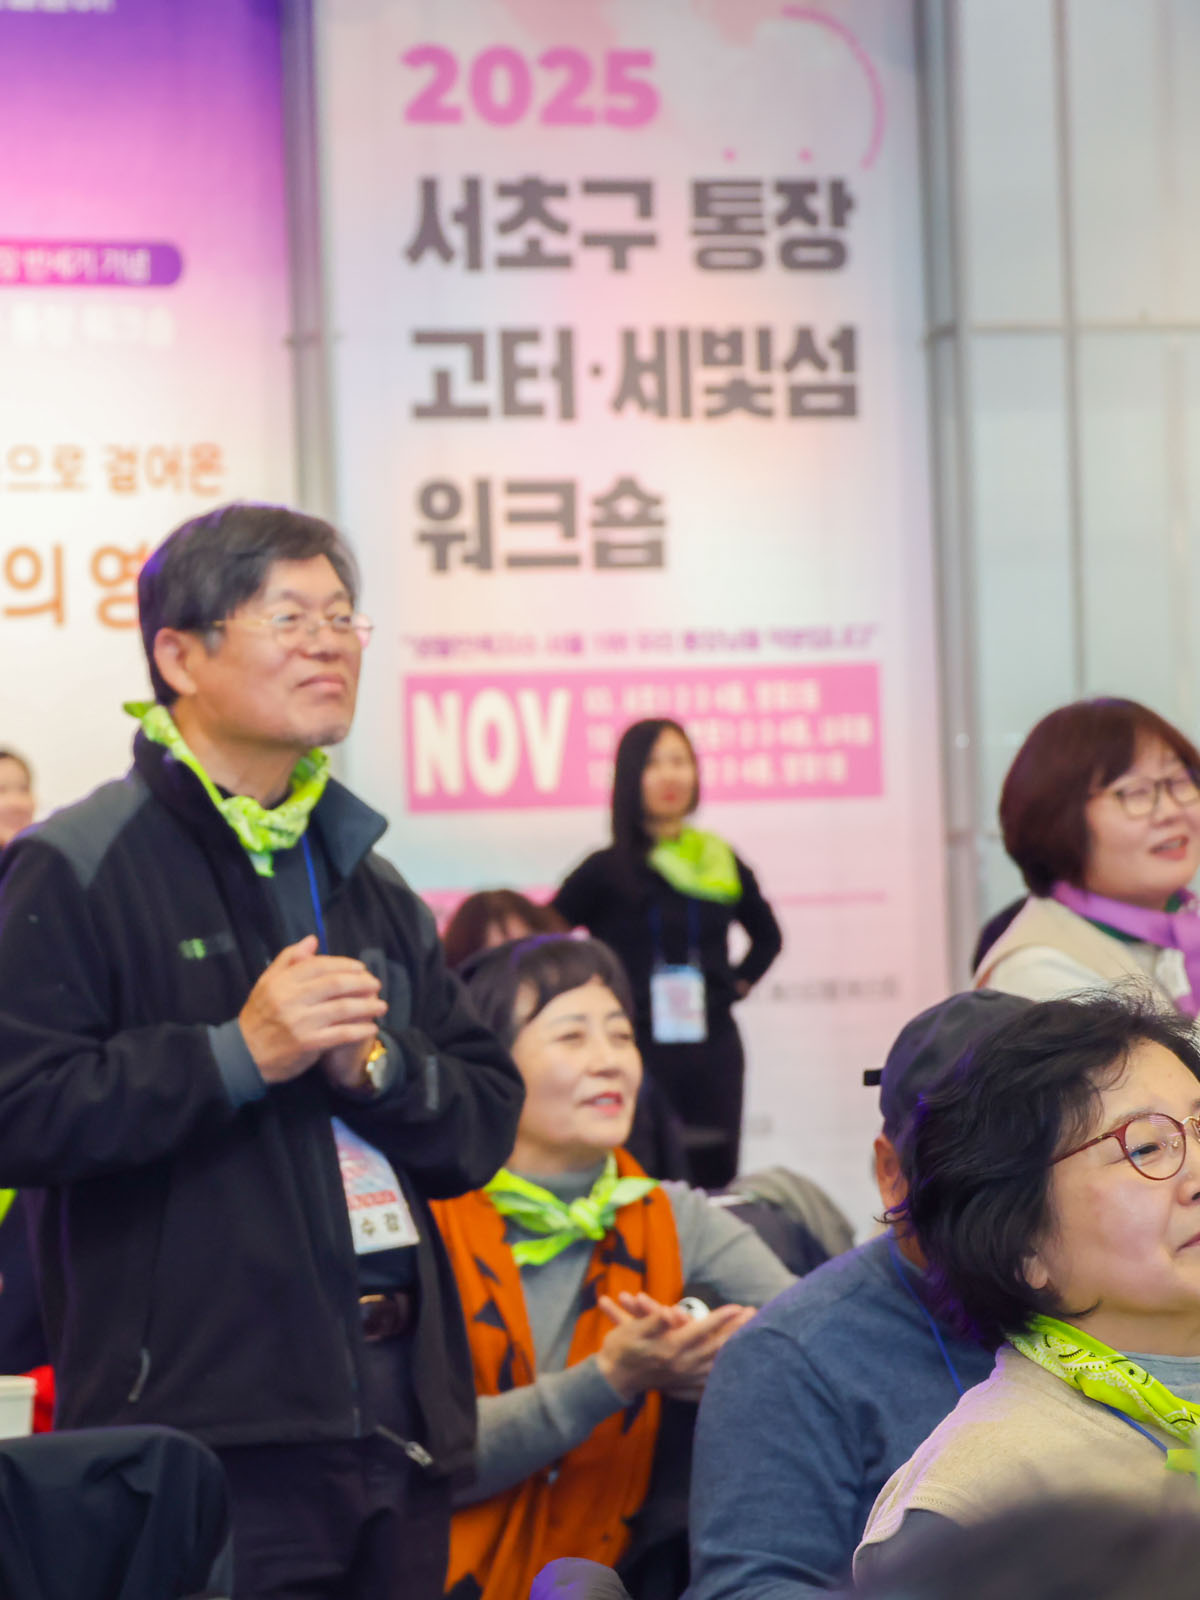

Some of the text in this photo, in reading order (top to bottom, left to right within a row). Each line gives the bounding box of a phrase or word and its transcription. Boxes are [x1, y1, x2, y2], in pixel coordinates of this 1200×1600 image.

[402, 46, 660, 127] 2025
[406, 176, 855, 271] 서초구 통장
[416, 478, 667, 572] 워크숍
[412, 687, 571, 797] NOV
